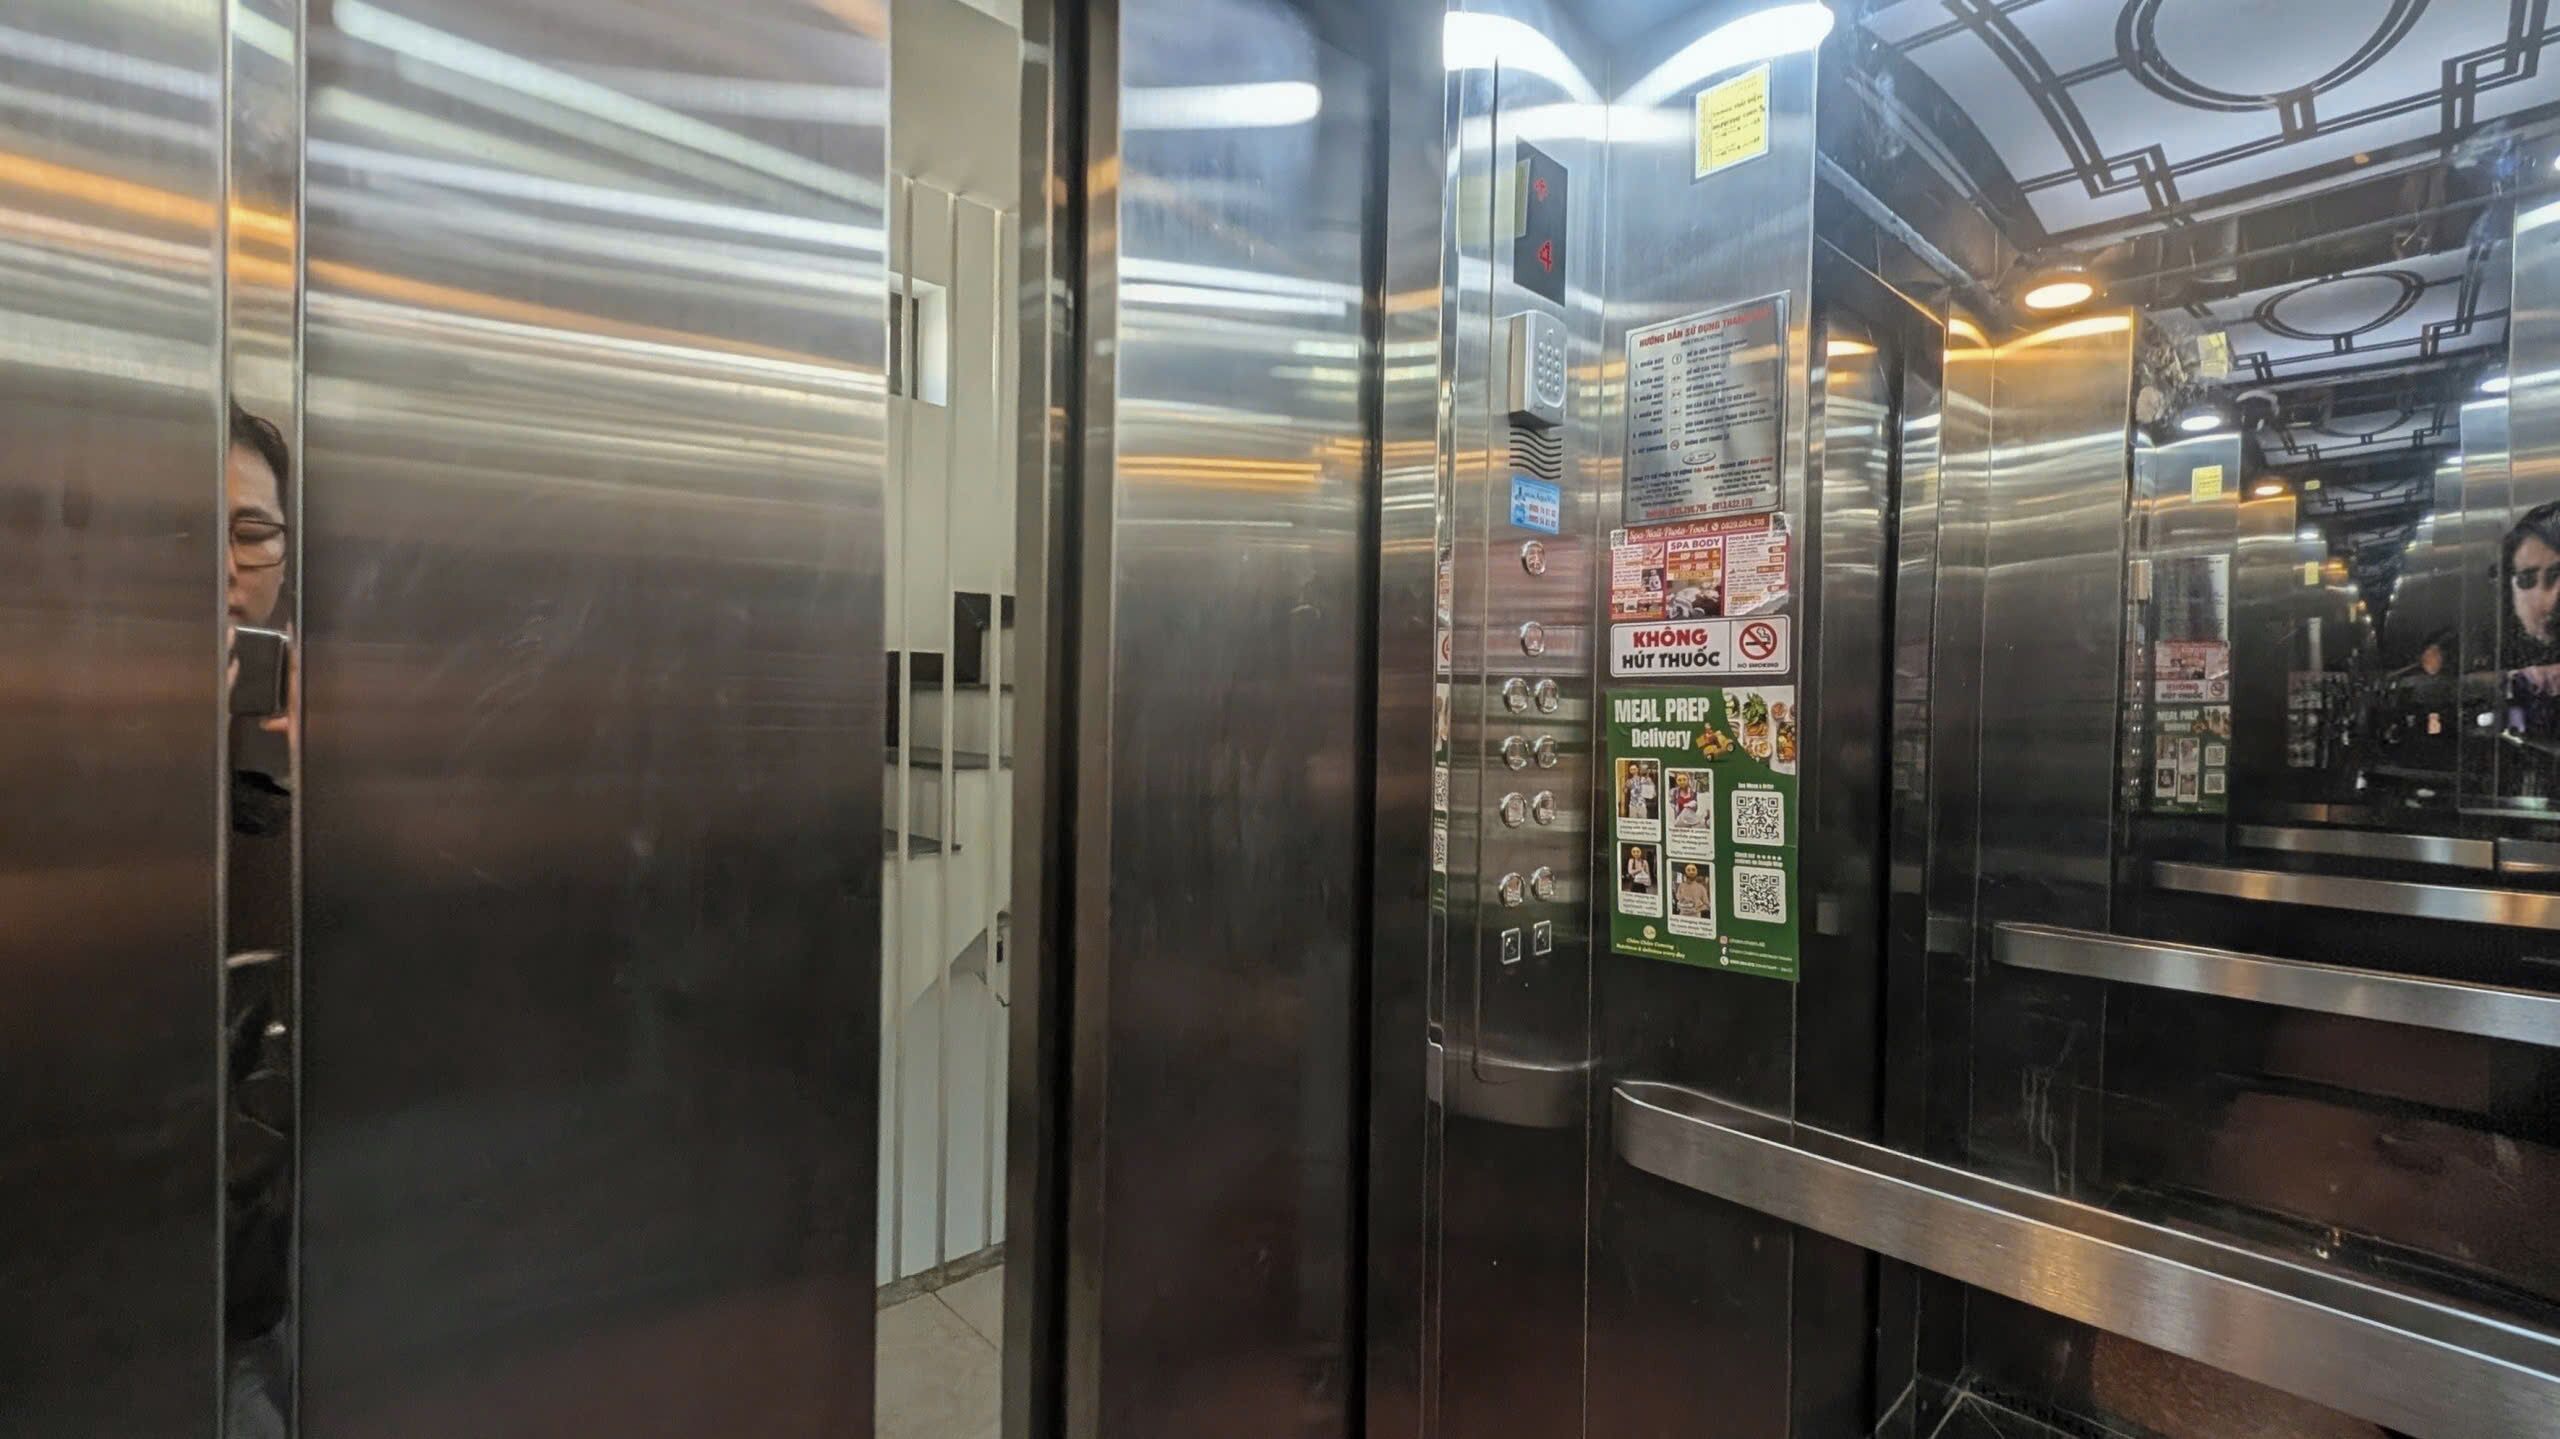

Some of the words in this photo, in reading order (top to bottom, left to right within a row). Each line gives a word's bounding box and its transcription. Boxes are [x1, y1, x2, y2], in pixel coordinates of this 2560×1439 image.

[1539, 240, 1553, 272] 4
[1670, 541, 1690, 550] SPA
[1692, 538, 1720, 548] BODY
[1633, 626, 1708, 648] KHÔNG
[1622, 650, 1655, 669] HÚT
[1658, 646, 1720, 668] THUỐC
[1614, 698, 1661, 723] MEAL
[1665, 697, 1711, 723] PREP
[1631, 728, 1692, 750] Delivery
